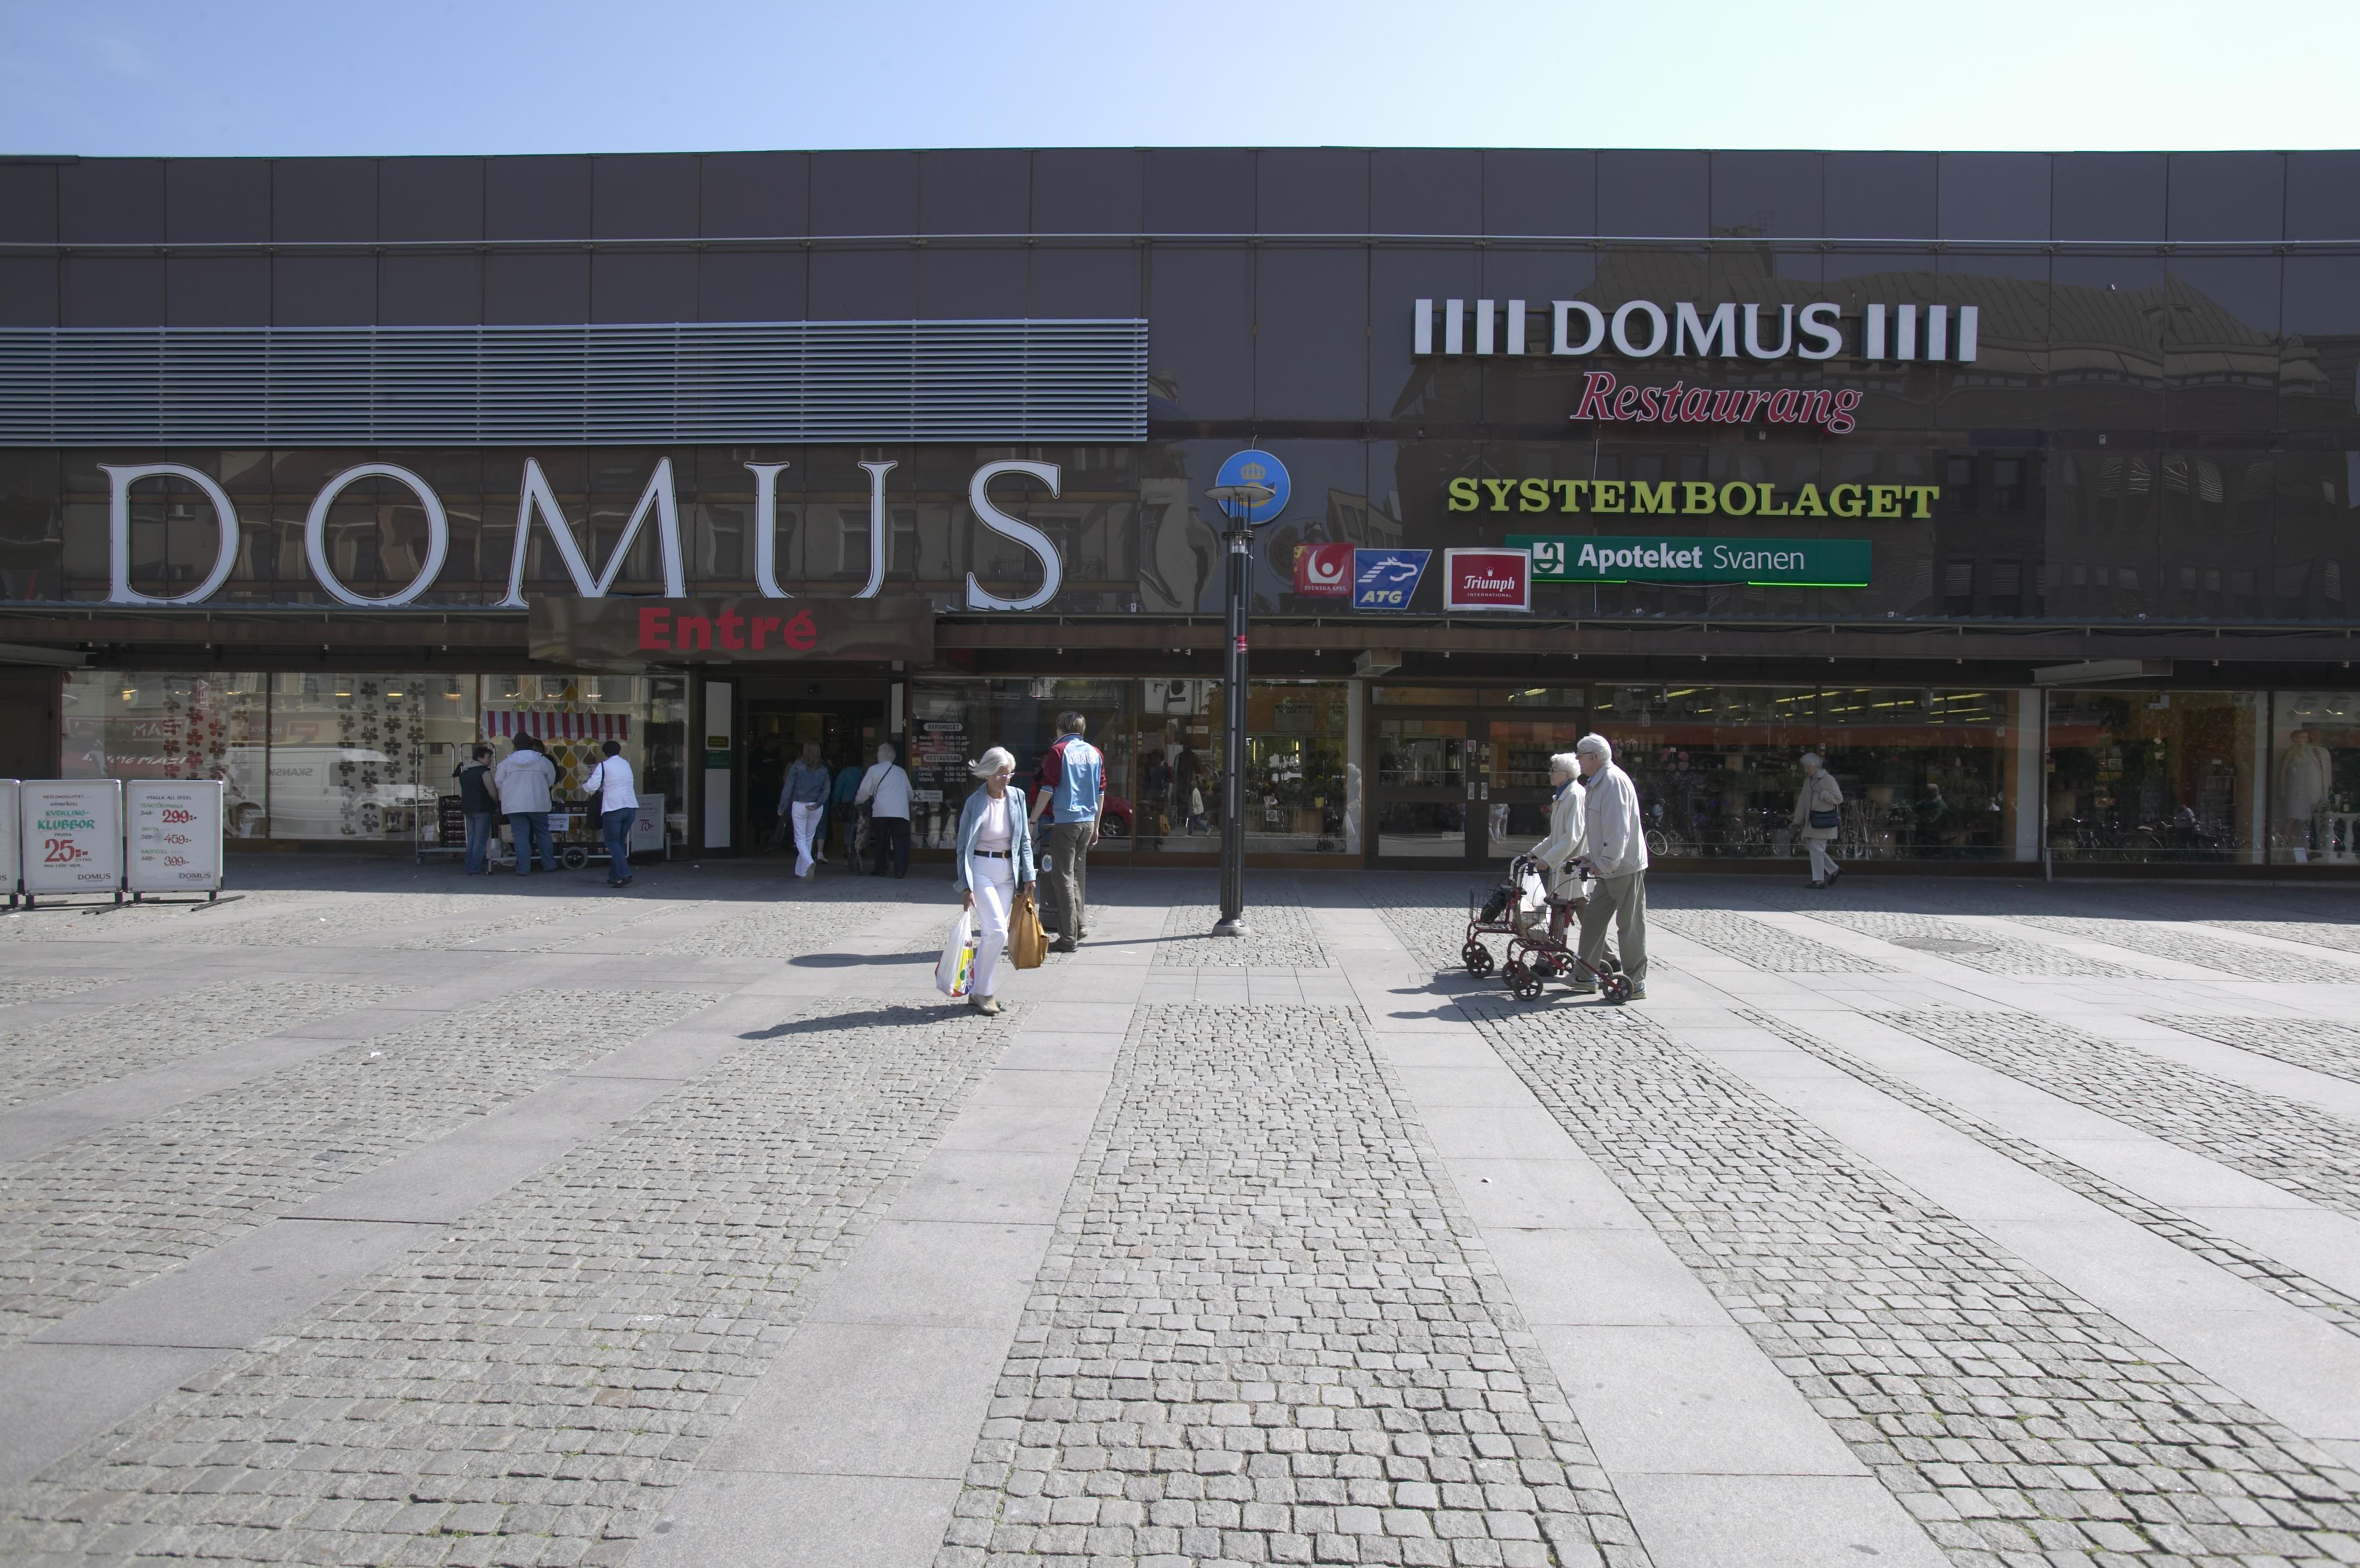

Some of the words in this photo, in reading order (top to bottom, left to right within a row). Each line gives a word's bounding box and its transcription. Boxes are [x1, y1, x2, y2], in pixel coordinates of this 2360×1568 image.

[1550, 300, 1843, 361] DOMUS
[1569, 371, 1864, 435] Restaurang
[1448, 477, 1940, 519] SYSTEMBOLAGET
[98, 457, 1063, 611] DOMUS
[1577, 543, 1703, 575] Apoteket
[1713, 545, 1805, 570] Svanen
[1463, 574, 1515, 591] Triumph
[1360, 590, 1402, 603] ATG
[638, 607, 818, 652] Entré
[37, 819, 96, 830] KLUBBOR
[162, 809, 197, 823] 299:-
[44, 838, 89, 862] 25:-
[163, 833, 192, 844] 459:-
[163, 855, 190, 866] 399:-
